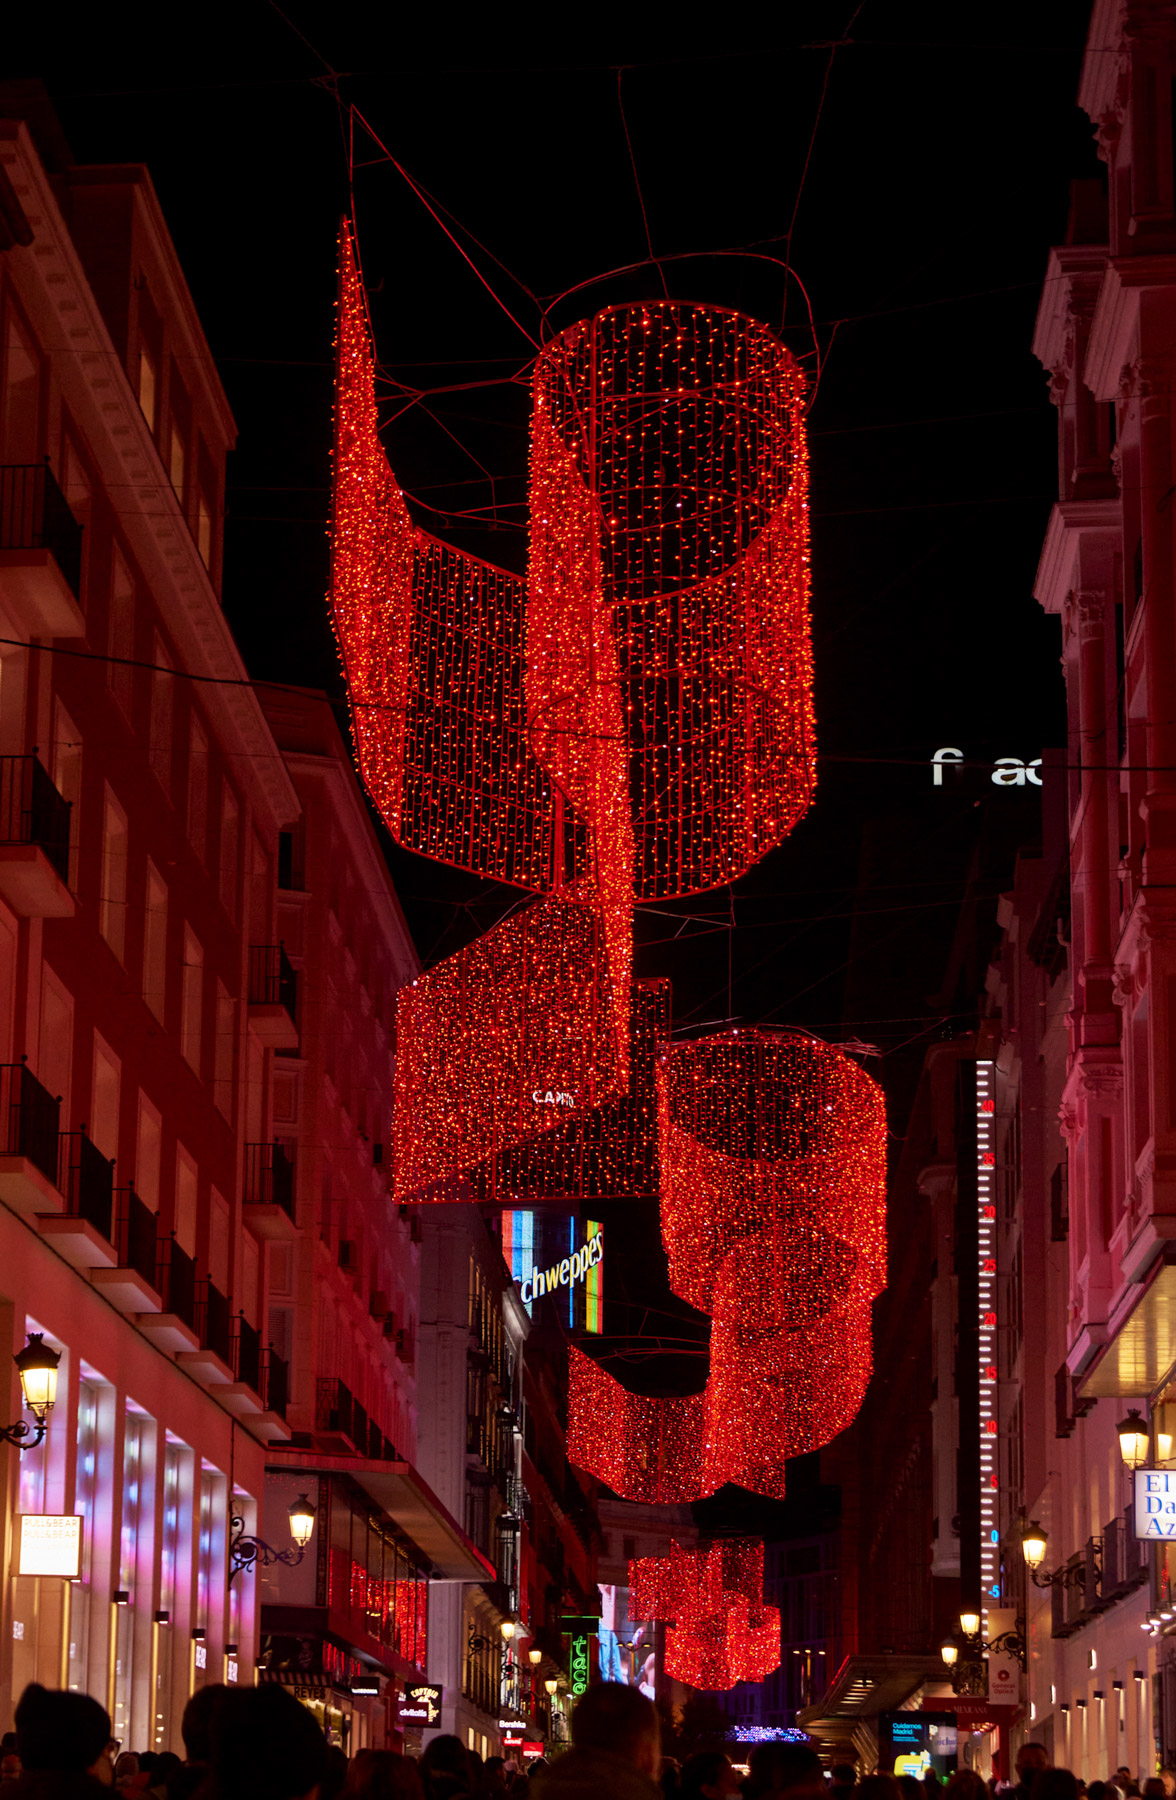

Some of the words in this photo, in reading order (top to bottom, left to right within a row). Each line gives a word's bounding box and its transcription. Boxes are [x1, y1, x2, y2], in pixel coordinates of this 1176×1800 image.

[981, 1100, 995, 1112] 40
[982, 1153, 996, 1165] 35
[983, 1206, 996, 1218] 30
[513, 1231, 603, 1304] chweppes
[983, 1259, 997, 1271] 25
[984, 1313, 997, 1325] 20
[985, 1367, 998, 1379] 15
[985, 1420, 998, 1433] 10
[990, 1475, 998, 1488] 5
[1144, 1473, 1170, 1493] El
[1144, 1495, 1176, 1514] Da
[991, 1529, 999, 1543] 0
[988, 1585, 1000, 1598] -5
[572, 1635, 587, 1695] taco
[294, 1686, 326, 1700] REYES
[499, 1720, 526, 1729] Bershka
